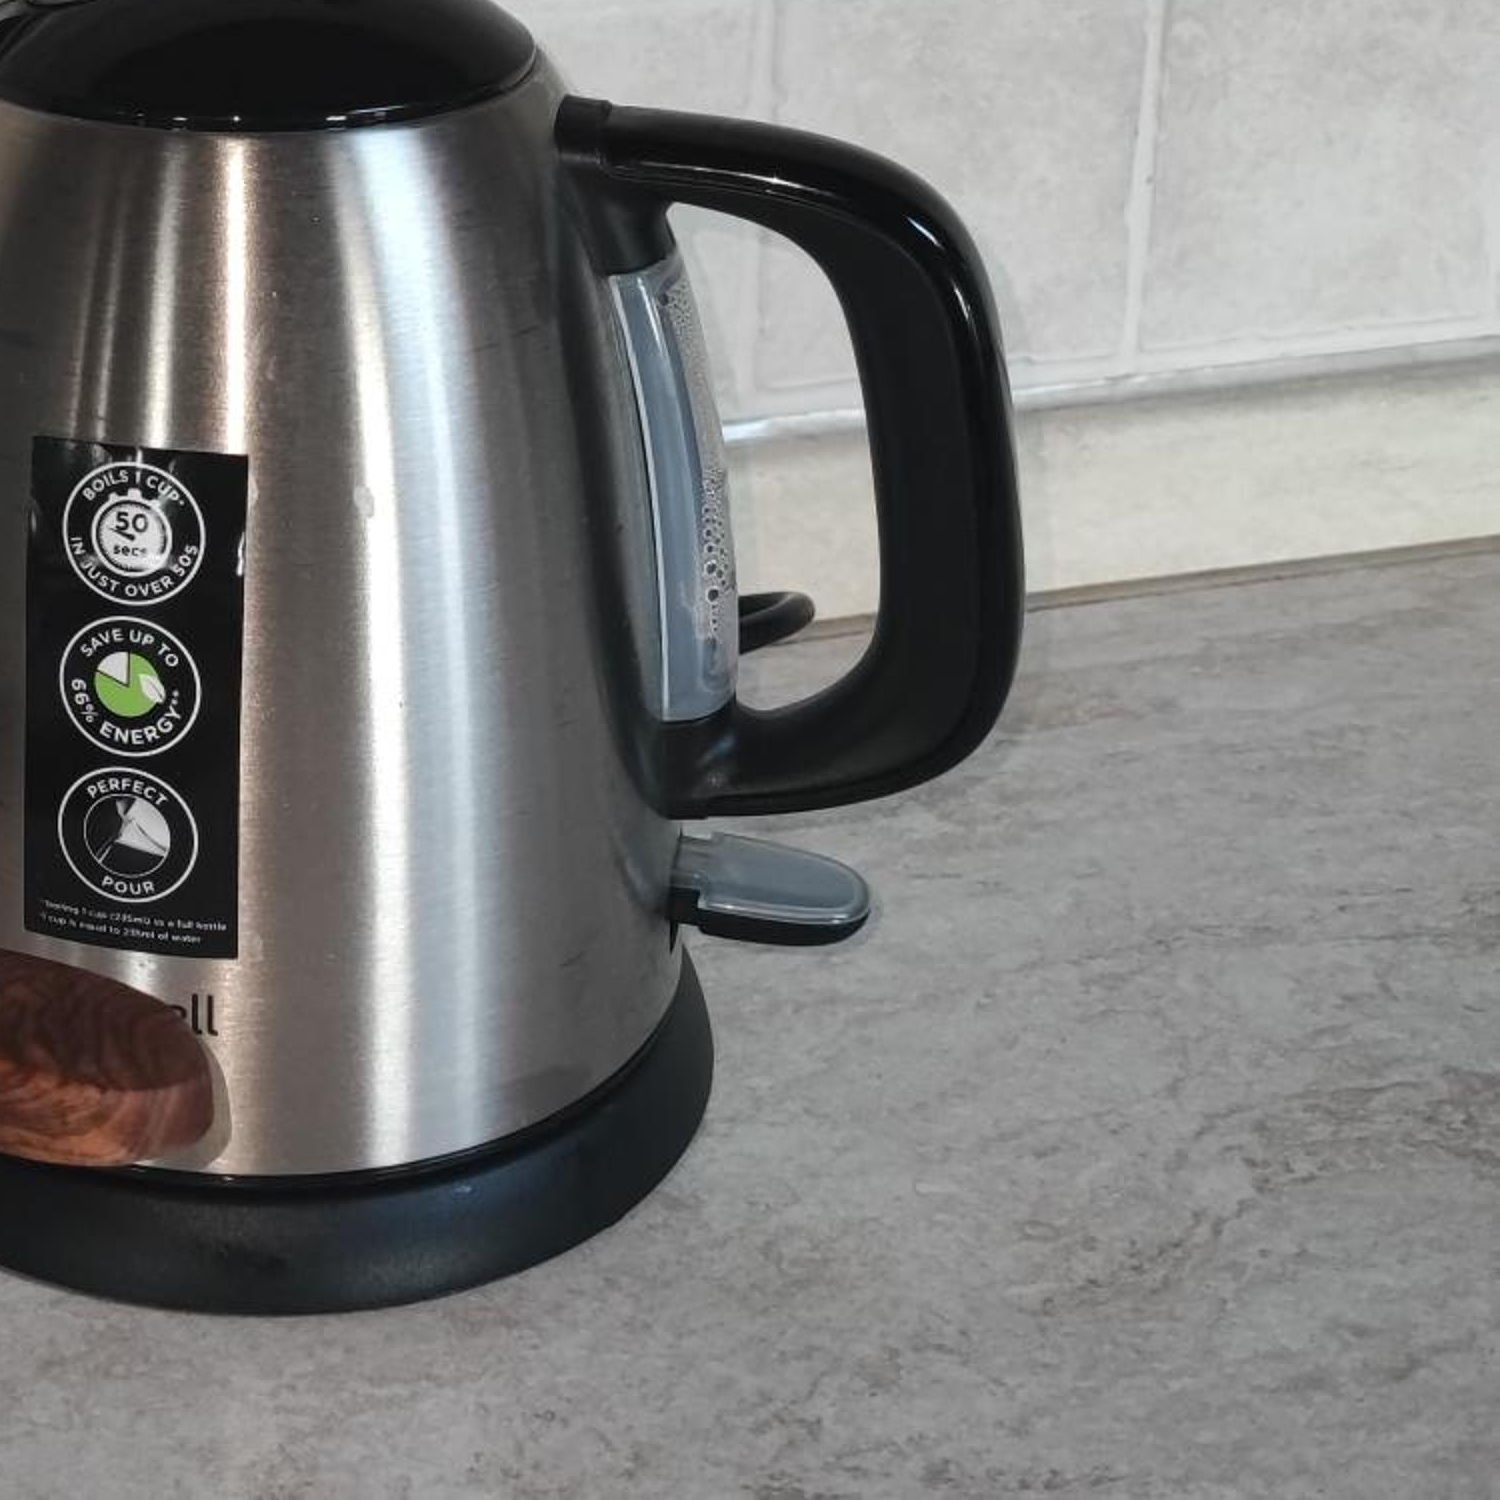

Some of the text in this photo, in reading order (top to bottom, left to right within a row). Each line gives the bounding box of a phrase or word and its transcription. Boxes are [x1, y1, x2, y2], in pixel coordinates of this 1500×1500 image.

[82, 469, 129, 501] BOILS
[115, 511, 149, 533] 50
[71, 536, 86, 556] IN
[81, 559, 120, 592] JUST
[124, 575, 174, 597] OVER
[80, 627, 179, 668] SAVE UP TO
[71, 678, 100, 723] 66%
[86, 777, 168, 806] PERFECT
[102, 875, 155, 896] POUR
